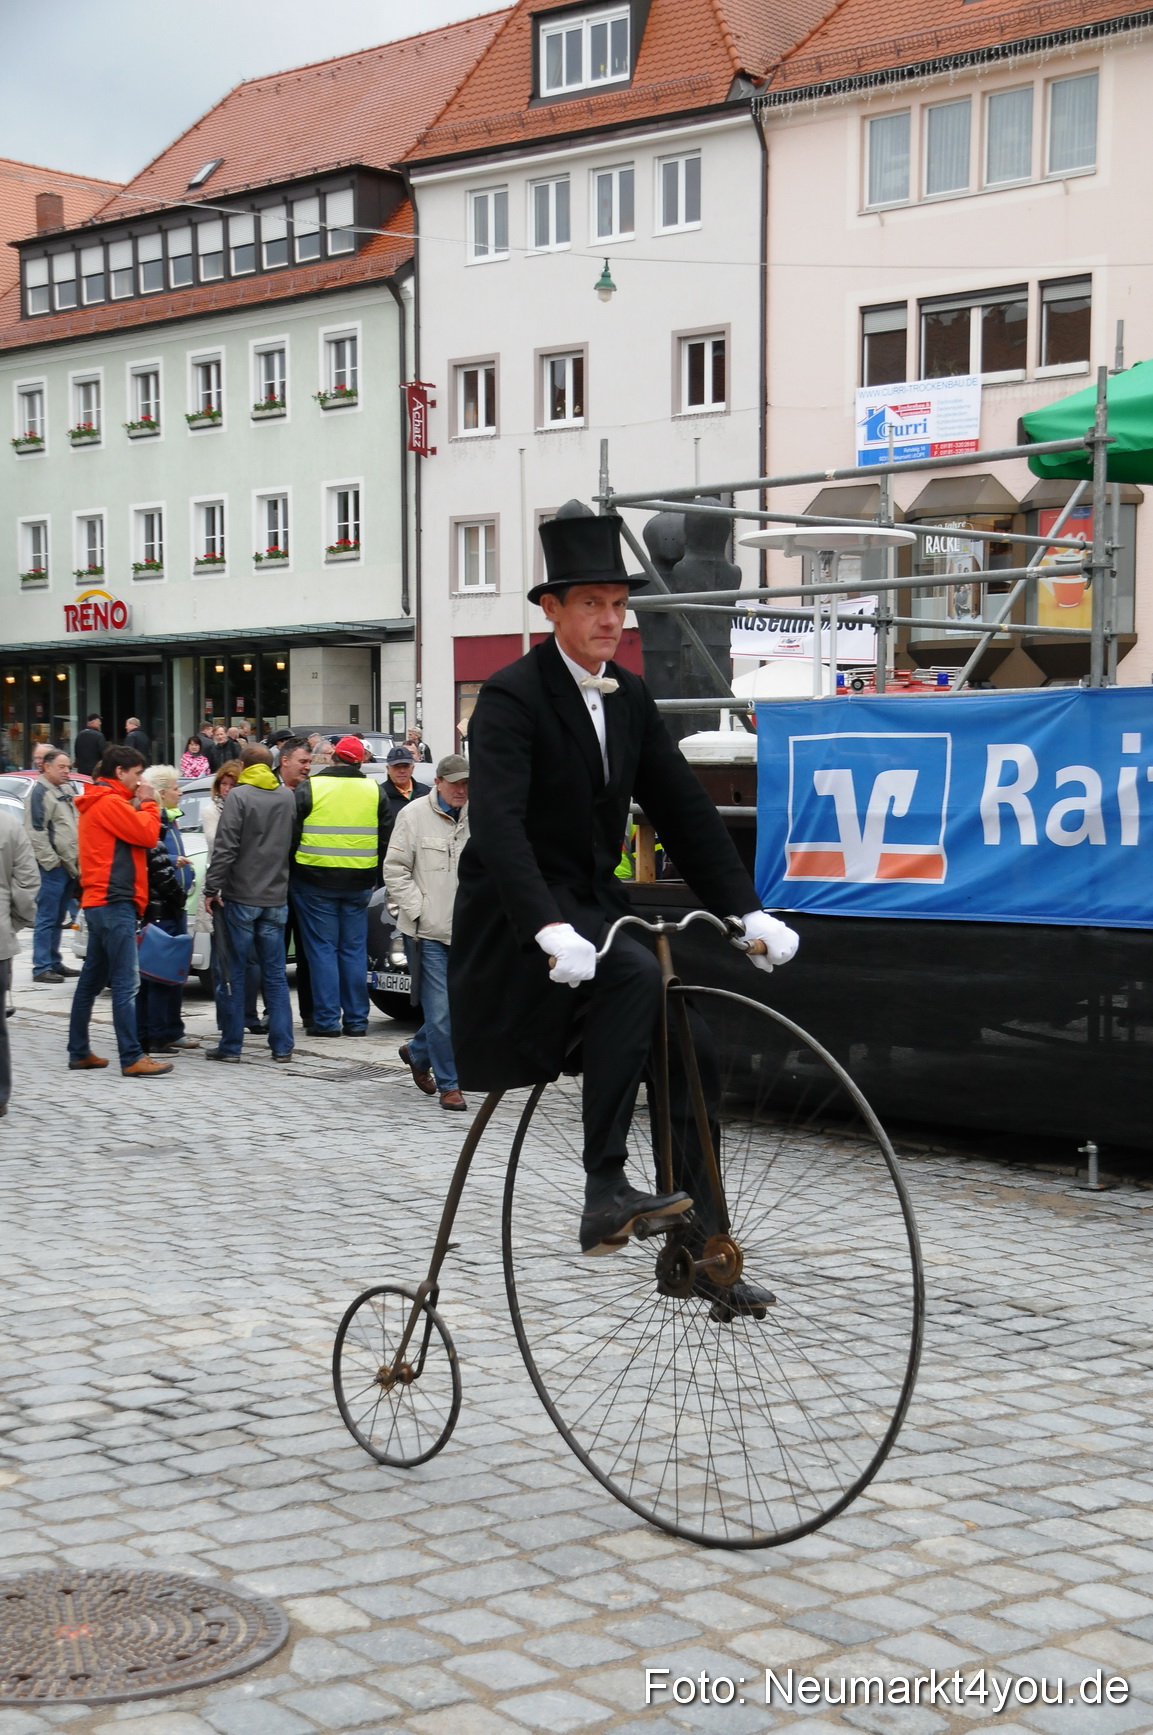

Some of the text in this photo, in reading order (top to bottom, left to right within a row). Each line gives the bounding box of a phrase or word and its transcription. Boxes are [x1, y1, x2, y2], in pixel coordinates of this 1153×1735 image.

[858, 378, 978, 398] WWW.CURRI-TROCKENBAU.DE
[412, 397, 424, 448] Achatz
[925, 535, 960, 554] RACKL
[64, 600, 128, 632] RENO
[980, 732, 1153, 846] Rai
